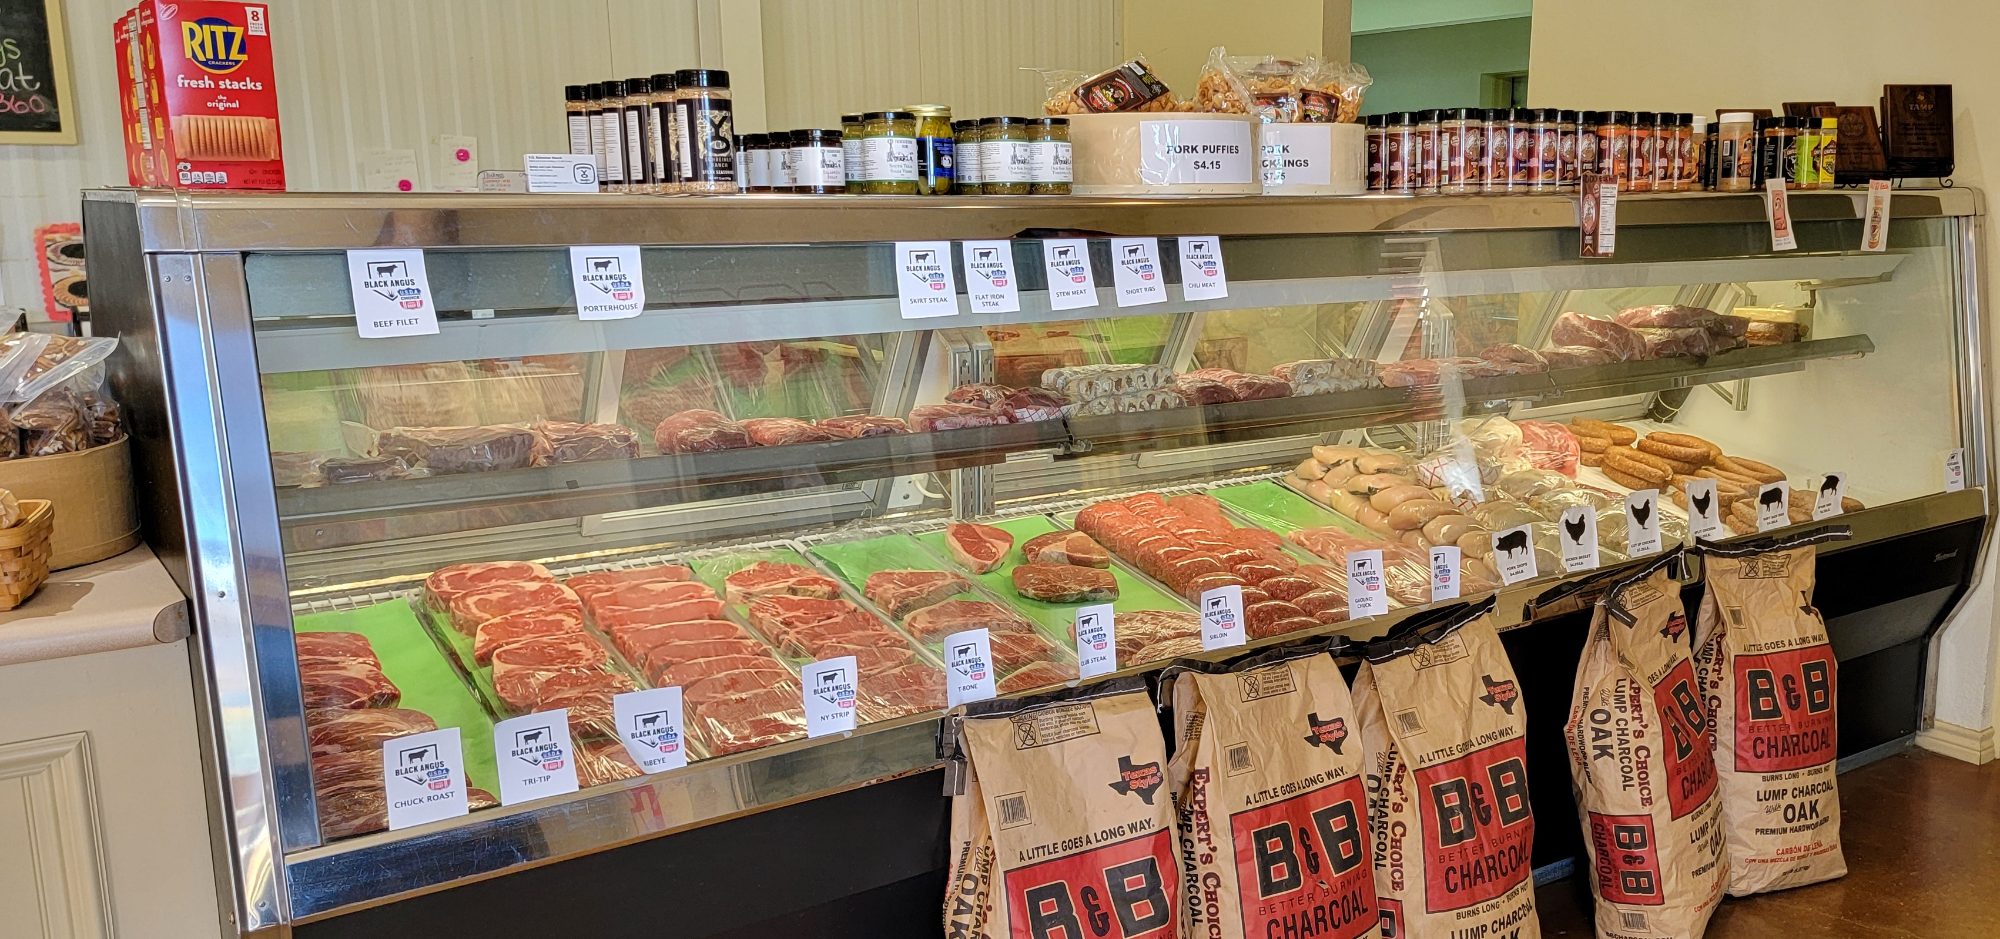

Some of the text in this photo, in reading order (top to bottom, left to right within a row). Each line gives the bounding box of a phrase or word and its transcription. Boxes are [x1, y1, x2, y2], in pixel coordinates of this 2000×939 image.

[251, 11, 259, 22] 8
[181, 21, 248, 61] RITZ
[177, 75, 262, 90] fresh stacks
[207, 100, 239, 110] original
[1166, 145, 1239, 154] PORK PUFFIES
[1193, 160, 1221, 169] $4.15
[390, 279, 415, 287] ANGUS
[584, 303, 638, 312] PORTERHOUSE
[374, 318, 419, 328] BEEF FILET
[1210, 632, 1228, 640] SIRLOIN
[1764, 640, 1786, 651] GOES
[1788, 639, 1793, 647] A
[1795, 636, 1811, 646] LONG
[952, 657, 982, 668] BLACK ANGUS
[1091, 656, 1107, 664] STEAK
[813, 684, 851, 695] BLACK ANGUS
[958, 684, 978, 692] T-BONE
[1746, 659, 1830, 722] B&B
[831, 711, 850, 719] STRIP
[631, 726, 674, 739] BLACK ANGUS
[1312, 722, 1343, 735] Texas
[1589, 707, 1615, 761] OAK
[1613, 677, 1635, 792] LUMP CHARCOAL
[512, 743, 558, 757] BLACK ANGUS
[1419, 725, 1517, 765] A LITTLE LONG WAY.
[1753, 726, 1831, 760] CHARCOAL
[394, 761, 445, 776] BLACK ANGUS
[644, 757, 666, 766] RIBEYE
[522, 775, 551, 786] TRI-TIP
[1122, 765, 1157, 780] Texas
[1634, 745, 1653, 808] CHOICE
[1762, 773, 1783, 782] BURNS
[1785, 772, 1800, 780] LONG
[1129, 776, 1160, 790] Style
[1246, 766, 1348, 806] A LITTLE GOES LONG WAY.
[1757, 779, 1833, 802] LUMP CHARCOAL
[394, 791, 455, 808] CHUCK ROAST
[1429, 756, 1531, 849] B&B
[1193, 766, 1218, 866] EXPERT'S
[1783, 799, 1819, 823] OAK
[1374, 787, 1390, 871] CHARCOAL
[1690, 821, 1709, 844] LUMP
[1755, 827, 1788, 835] PREMIUM
[1019, 817, 1155, 862] A LITTLE GOES A LONG WAY.
[1709, 824, 1722, 856] OAK
[1251, 799, 1364, 900] B&B
[1390, 821, 1407, 893] CHOICE
[1438, 843, 1485, 864] BETTER
[1593, 823, 1611, 891] CHARCOAL
[1776, 845, 1801, 855] CARBÓN
[956, 840, 971, 881] PREMIUM
[1444, 835, 1529, 894] CHARCOAL
[1612, 823, 1656, 897] B&B
[1691, 860, 1715, 879] PREMIUM
[1183, 838, 1203, 927] CHARCOAL
[1259, 868, 1367, 916] BETTER BURNING
[949, 873, 979, 939] OAK
[1267, 886, 1369, 939] CHARCOAL
[1456, 907, 1480, 920] BURNS
[1482, 901, 1500, 913] LONG
